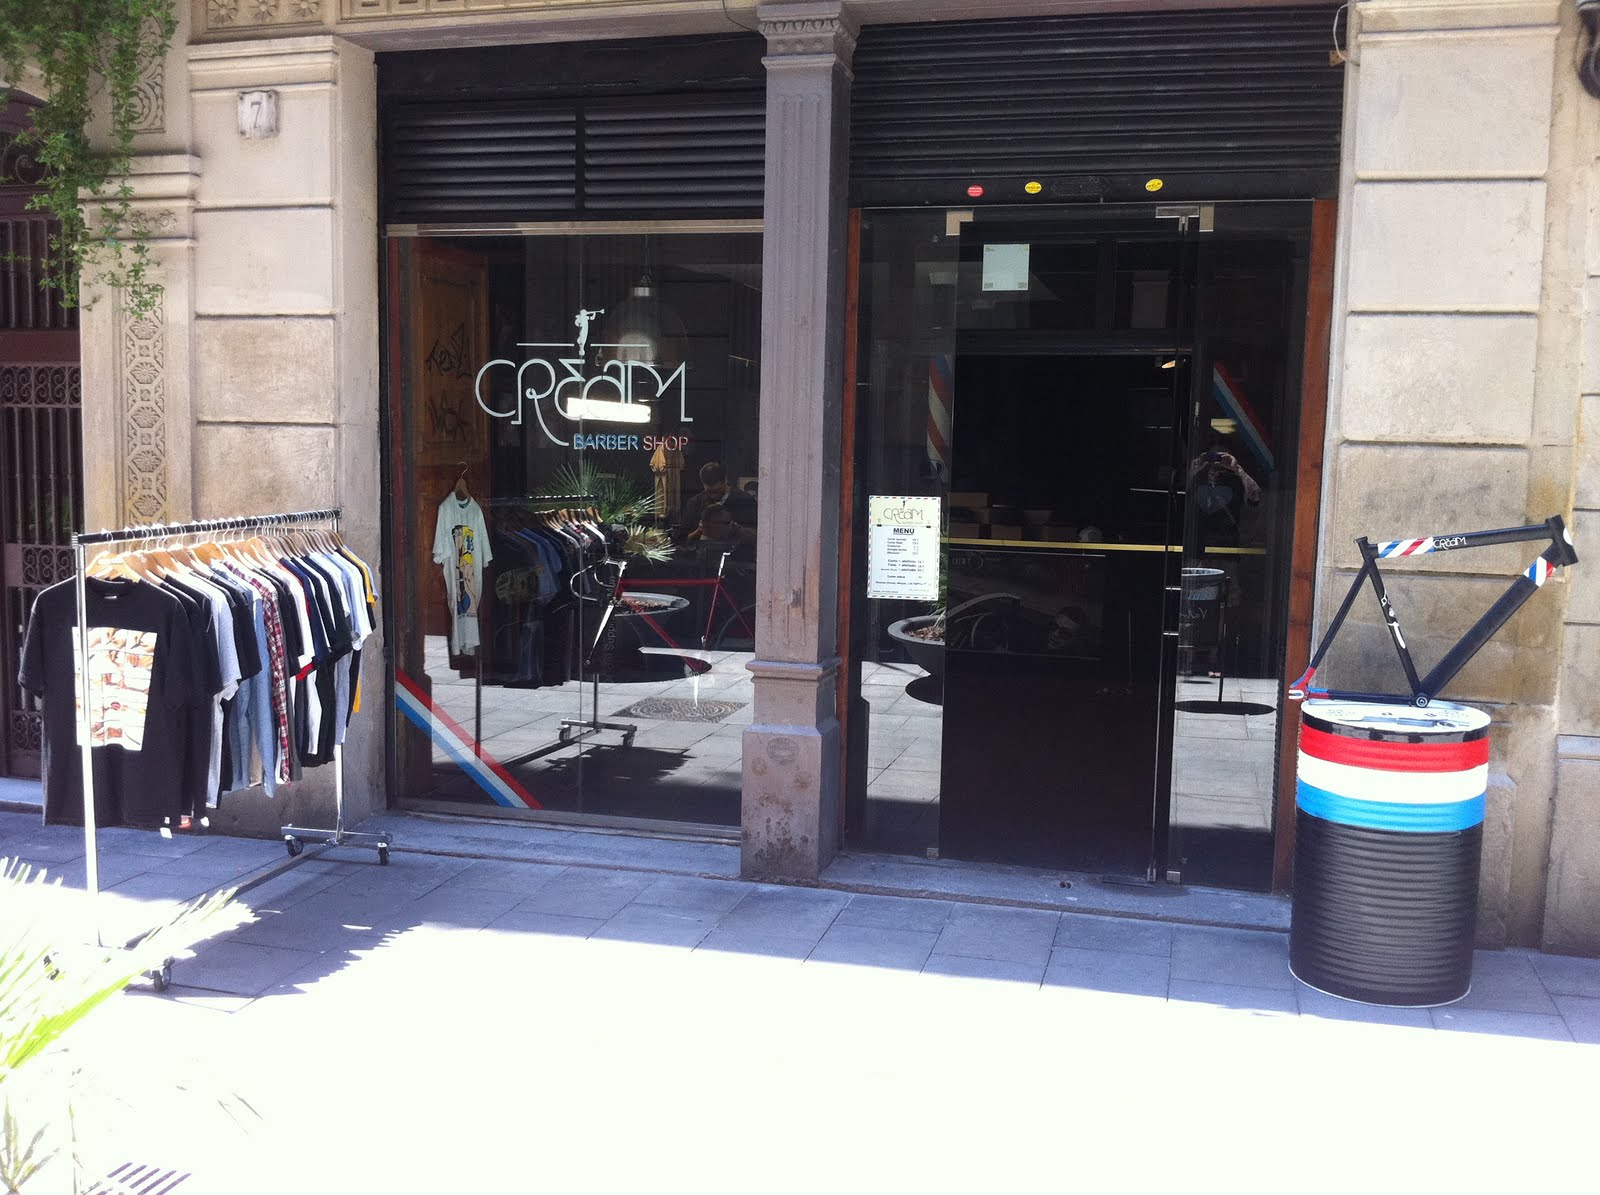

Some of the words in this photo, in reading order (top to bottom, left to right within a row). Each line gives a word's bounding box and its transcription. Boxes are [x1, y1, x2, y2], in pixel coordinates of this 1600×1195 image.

[250, 101, 262, 128] 7
[573, 432, 639, 451] BARBER
[642, 434, 689, 452] SHOP
